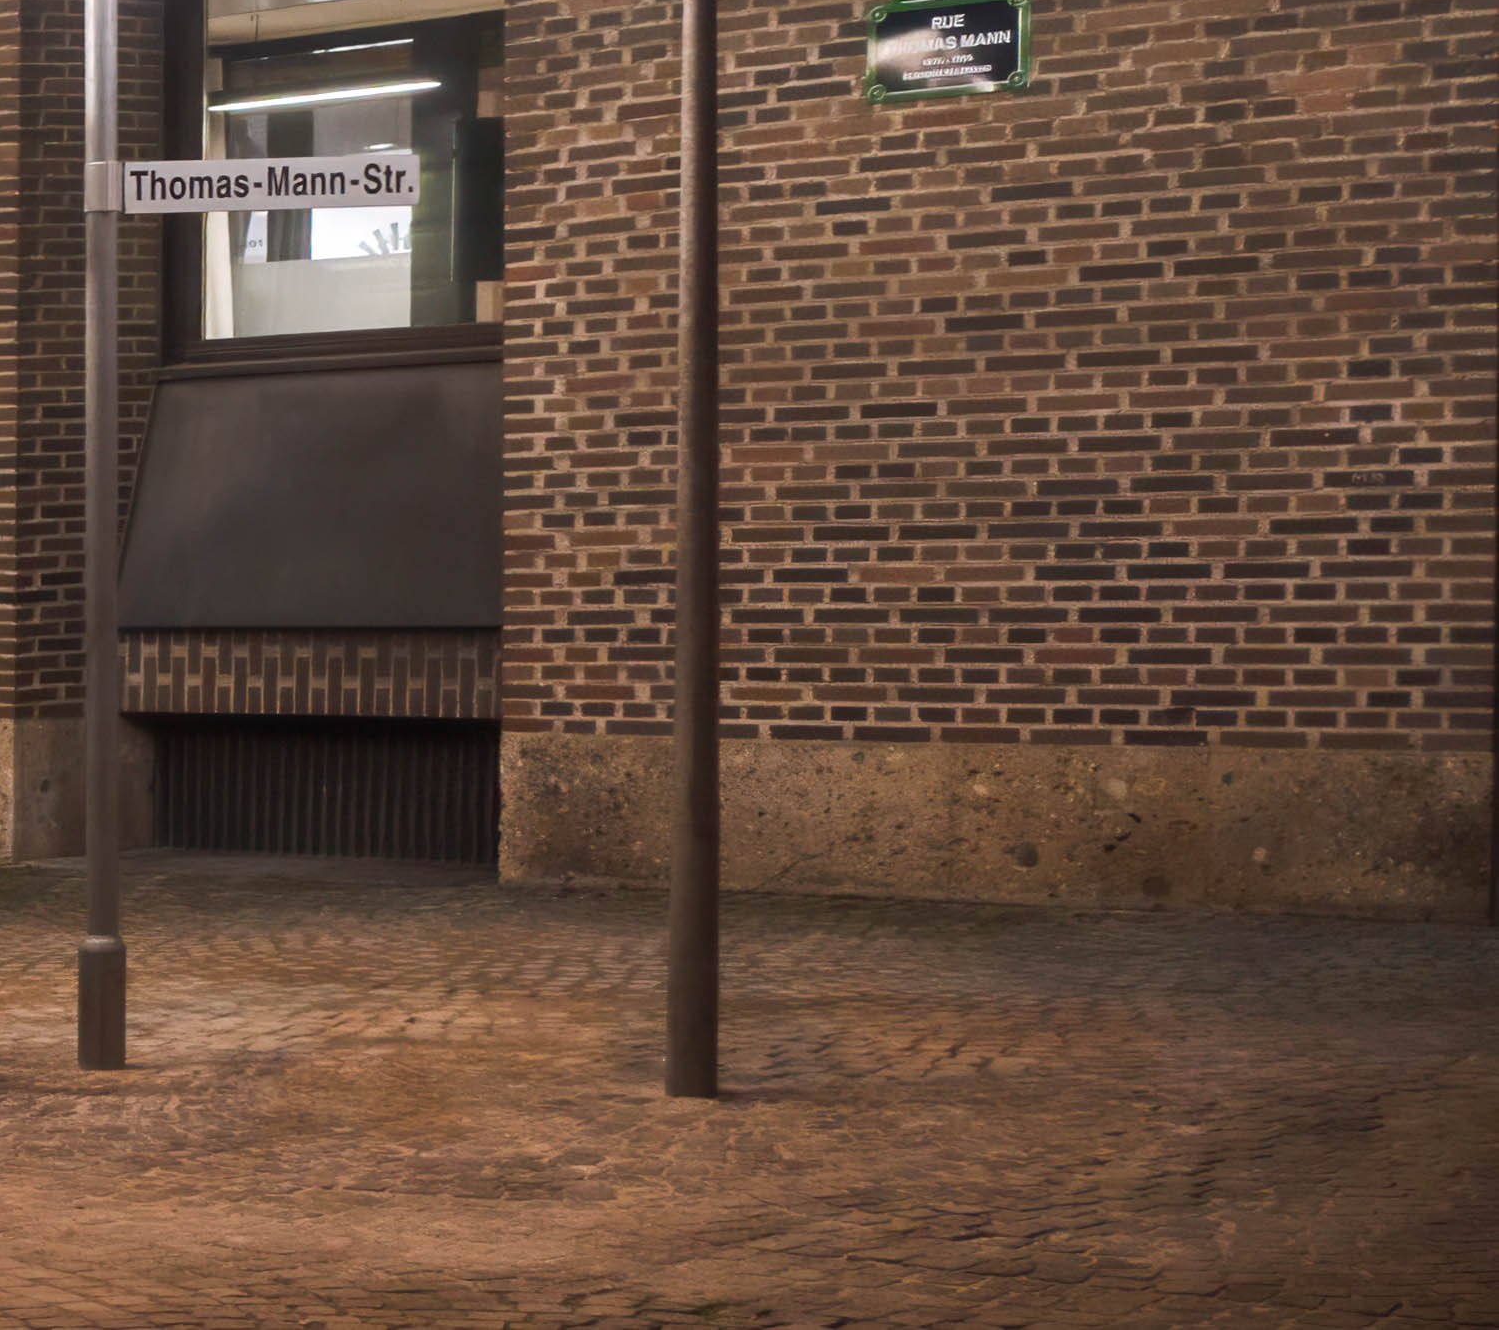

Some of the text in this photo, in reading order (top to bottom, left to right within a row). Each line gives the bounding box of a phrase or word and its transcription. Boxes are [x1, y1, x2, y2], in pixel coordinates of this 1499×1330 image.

[931, 13, 966, 29] RUE
[885, 30, 1012, 56] HOMAS MANN
[129, 163, 414, 201] Thomas-Mann-Str.
